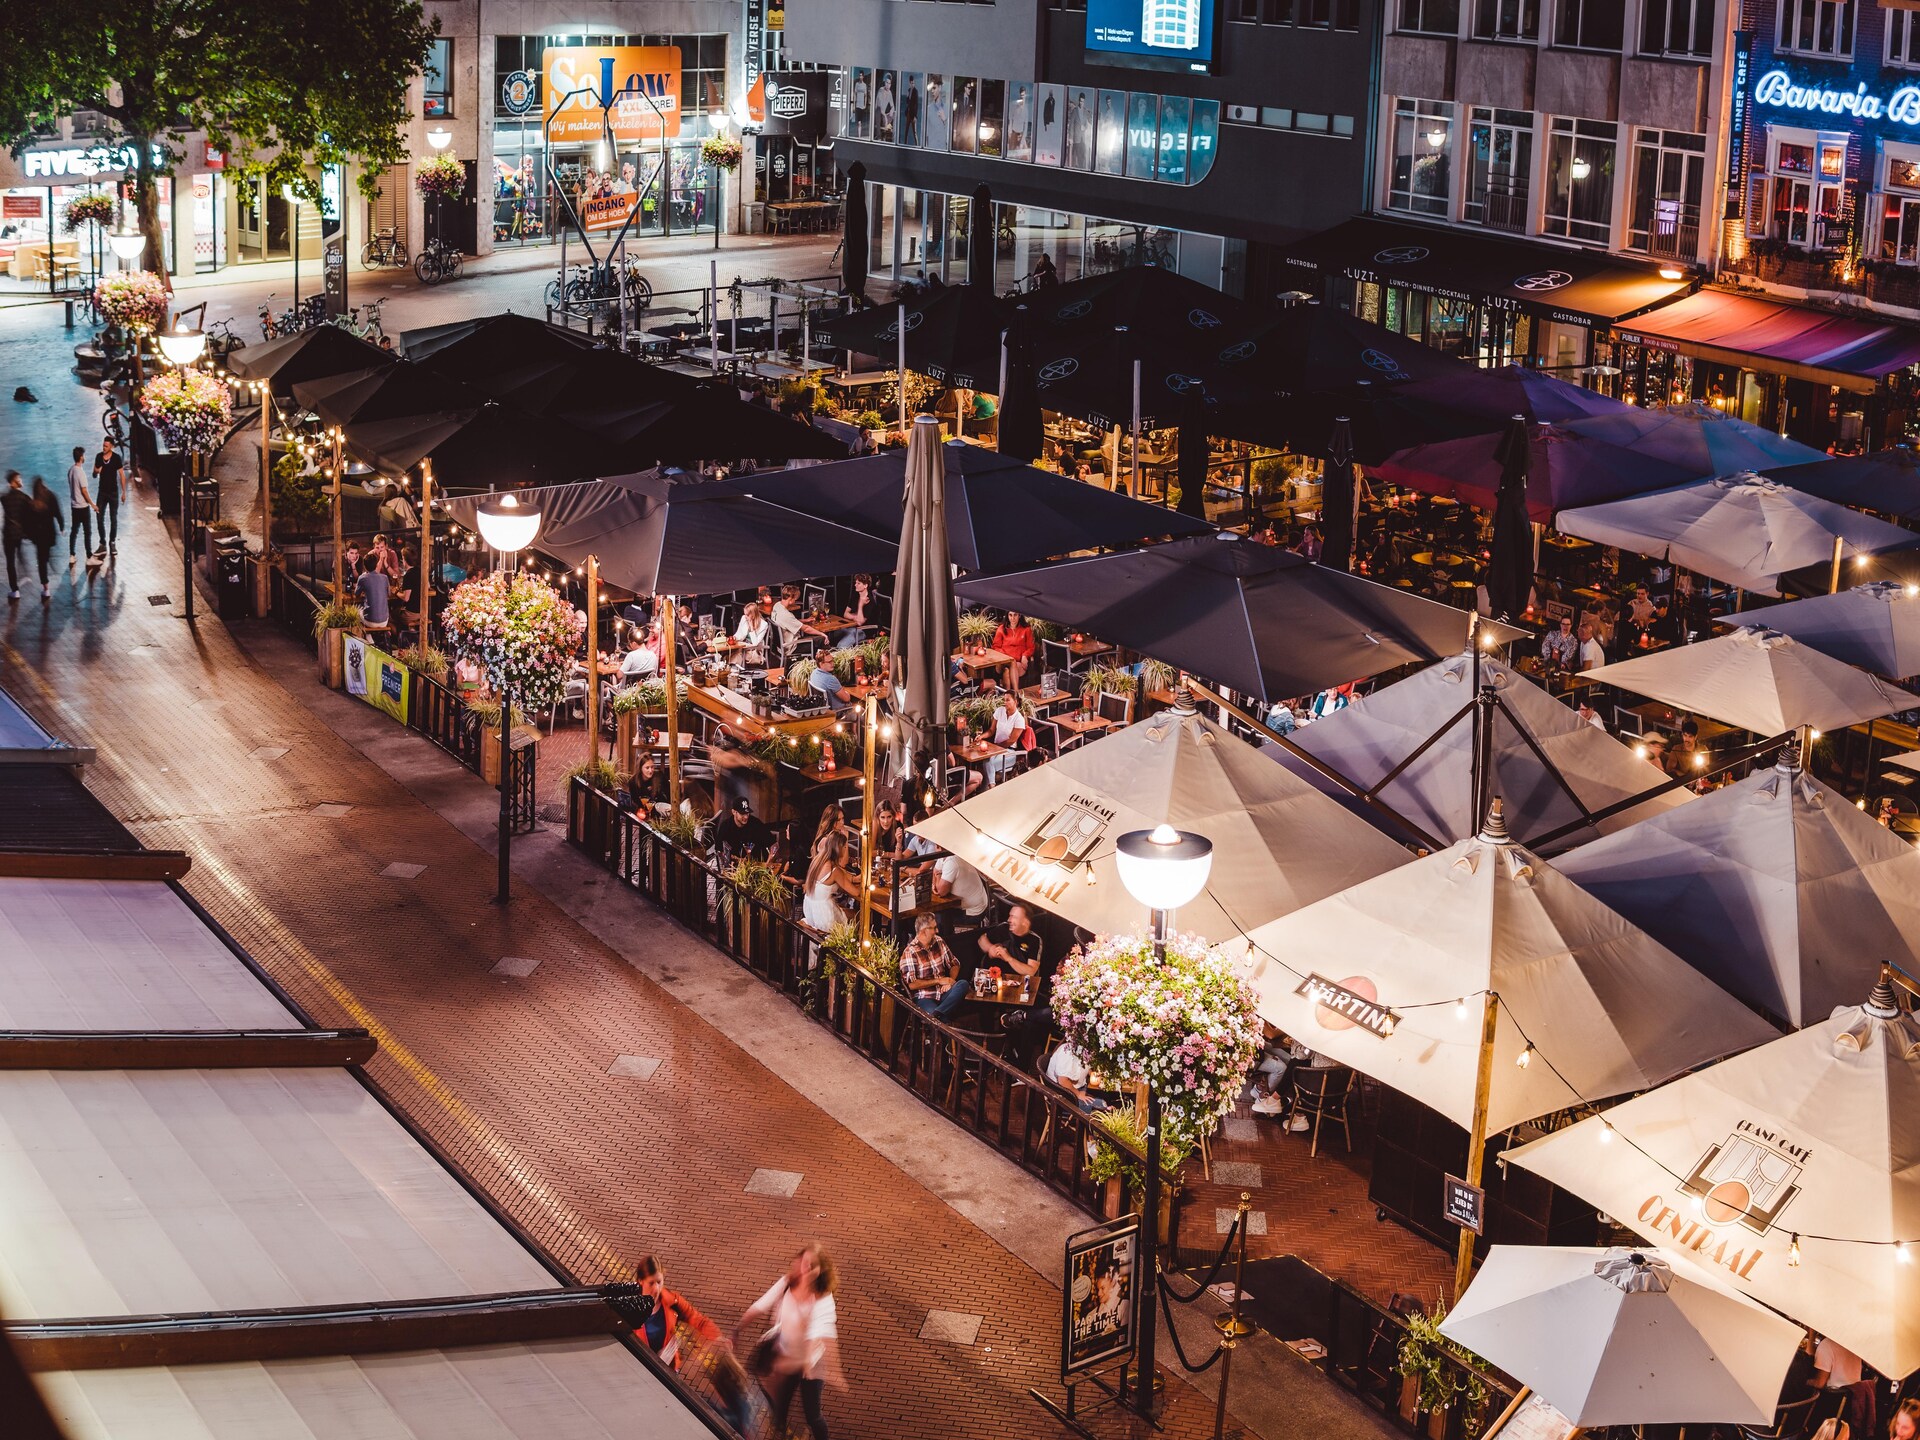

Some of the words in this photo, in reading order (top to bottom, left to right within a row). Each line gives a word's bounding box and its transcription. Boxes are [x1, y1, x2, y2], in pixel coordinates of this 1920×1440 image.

[1737, 51, 1748, 85] CAFÉ
[513, 83, 525, 100] 2
[1755, 70, 1882, 119] Bavaria
[622, 103, 641, 114] XXL
[644, 98, 673, 110] STORE!
[776, 96, 803, 109] PIEPERZ
[1734, 91, 1745, 131] DINER
[550, 122, 566, 135] Wij
[568, 118, 600, 132] maken
[604, 117, 648, 132] inkelen
[25, 150, 84, 178] FIVE
[1731, 139, 1740, 182] LUNCH
[586, 198, 625, 213] INGANG
[587, 214, 597, 222] OM
[599, 212, 607, 220] DE
[609, 208, 625, 218] HOEK
[1286, 258, 1318, 269] GASTROBAR
[1389, 278, 1409, 288] LUNCH
[1412, 283, 1435, 293] DINNER
[1438, 288, 1470, 300] COCKTAILS
[1553, 311, 1592, 326] GASTROBAR
[815, 334, 831, 344] LUZT
[1644, 338, 1656, 346] FOOD
[1661, 342, 1678, 350] DRINKS
[927, 367, 946, 381] LUZT
[954, 377, 973, 388] LUZT
[1088, 413, 1109, 430] LUZT
[1068, 793, 1094, 810] GRAND
[1093, 803, 1117, 823] CAFÉ
[1736, 1119, 1778, 1143] GRAND
[1778, 1139, 1813, 1165] CAFÉ
[1637, 1195, 1764, 1281] CENTRAAL
[1074, 1323, 1093, 1339] THE
[1094, 1314, 1120, 1332] TIME!
[1075, 1312, 1106, 1329] PARTY
